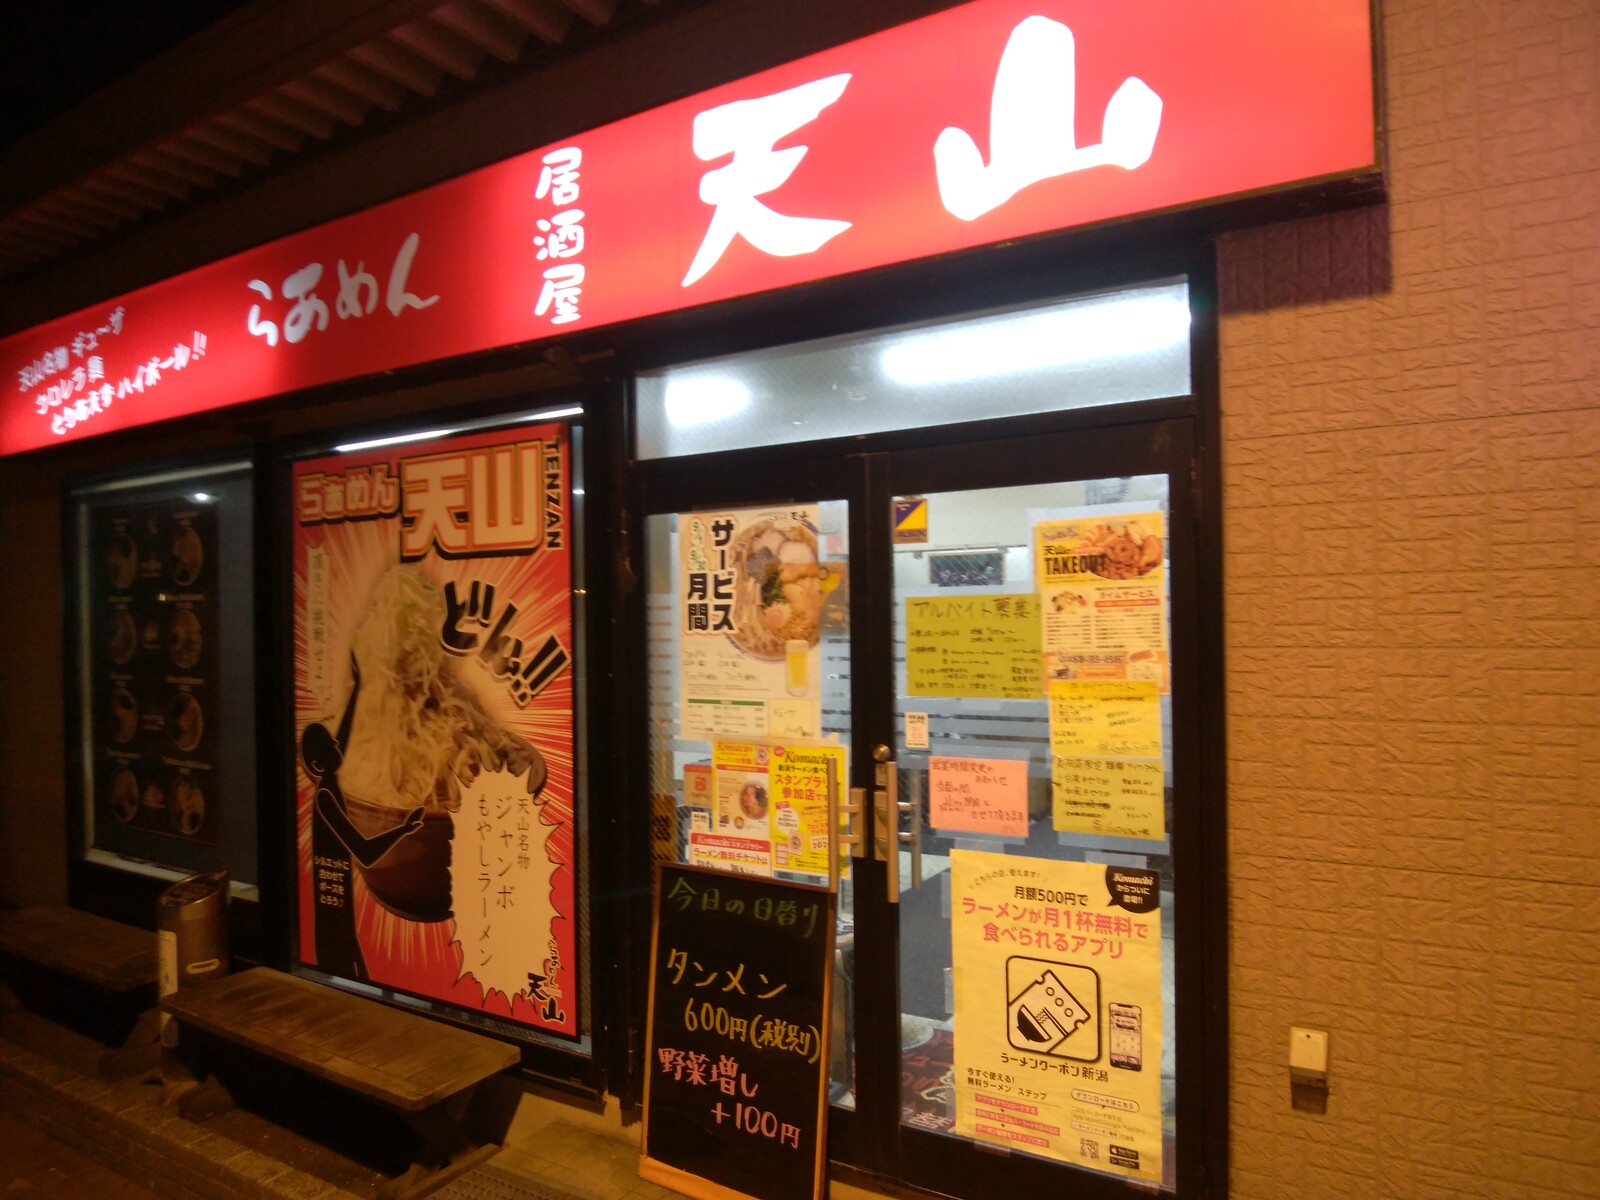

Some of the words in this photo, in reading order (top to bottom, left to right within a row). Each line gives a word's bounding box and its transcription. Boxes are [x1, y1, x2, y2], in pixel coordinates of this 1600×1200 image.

[681, 14, 1163, 287] 天山
[534, 146, 584, 323] 居酒屋
[401, 443, 542, 558] 天山
[544, 436, 563, 550] TENZAN
[711, 519, 735, 631] サービス
[1045, 554, 1107, 575] TAKEOUT
[687, 572, 709, 631] 月間
[495, 794, 516, 910] ジャンボ
[517, 798, 530, 870] 天山名物
[476, 793, 493, 967] もやしラーメン
[1014, 885, 1088, 906] 月額500円で
[1113, 873, 1154, 885] Komachi
[667, 877, 818, 938] 今日の日替り
[962, 897, 1149, 940] ラーメンが月1杯無料で
[983, 921, 1123, 959] 食べられるアプリ
[527, 972, 565, 1022] 天山
[667, 948, 787, 999] タンメン
[684, 997, 821, 1064] 600円(税別)
[658, 1048, 759, 1098] 野菜増し
[967, 1067, 1015, 1084] 今すぐ使える!
[967, 1077, 1011, 1092] 無料ラーメン
[1018, 1087, 1047, 1100] ステップ
[1000, 1052, 1109, 1083] ラーメンクーポン新潟
[711, 1102, 801, 1149] +100円
[1076, 1092, 1134, 1110] ダウンロードはこちら
